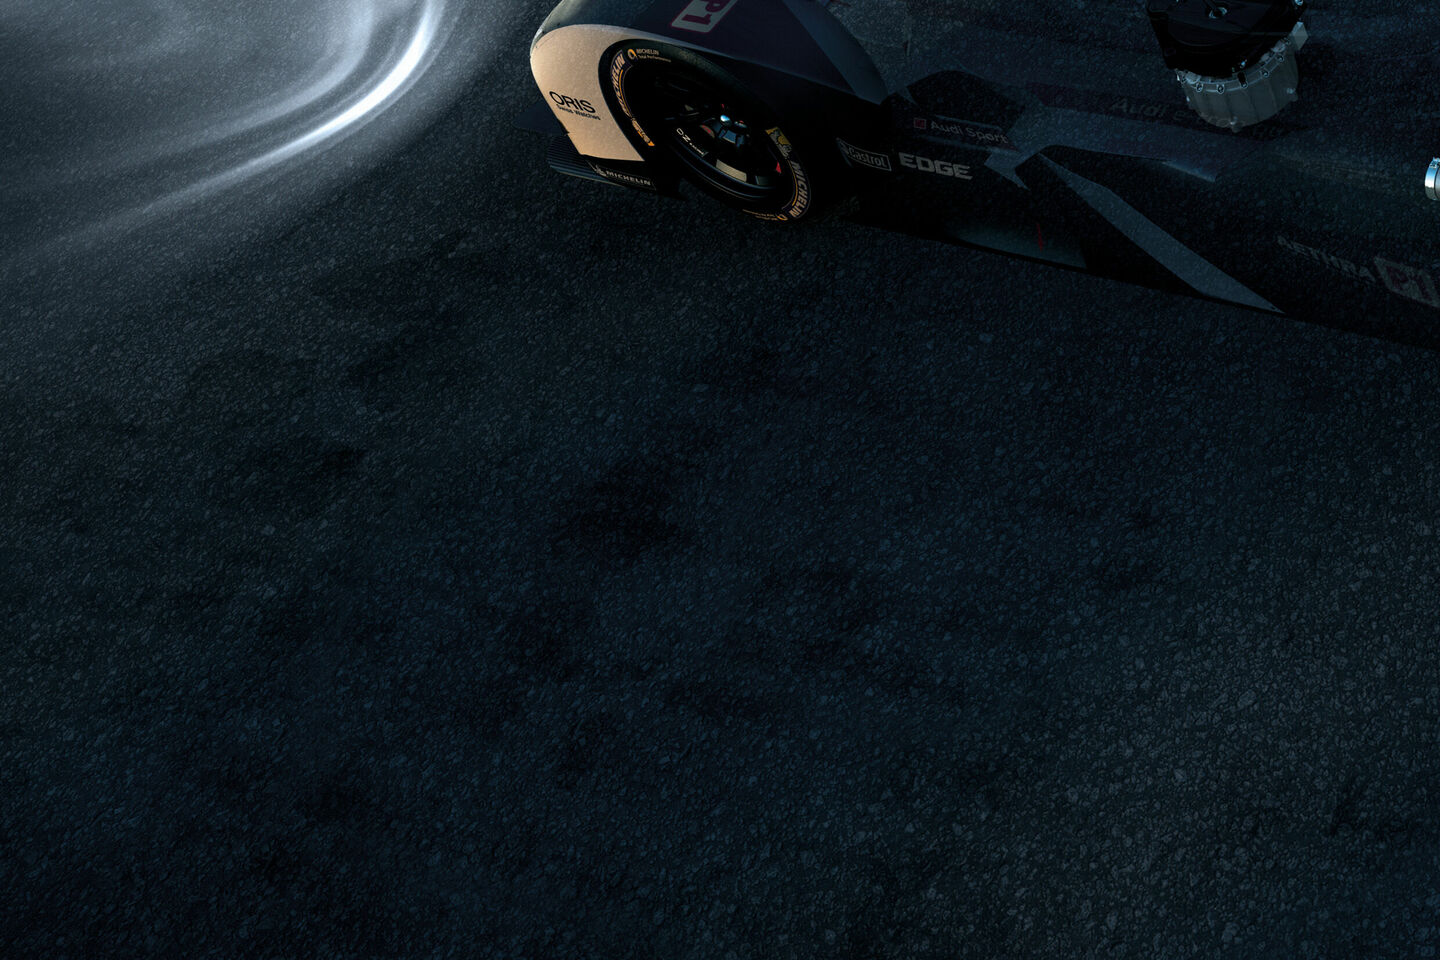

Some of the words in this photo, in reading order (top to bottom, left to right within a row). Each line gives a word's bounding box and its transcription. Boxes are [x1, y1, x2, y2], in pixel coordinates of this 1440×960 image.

[549, 91, 596, 114] ORIS
[930, 120, 963, 134] Audi
[965, 127, 1009, 145] Sport
[849, 148, 888, 168] Castrol
[898, 152, 973, 180] EDGE
